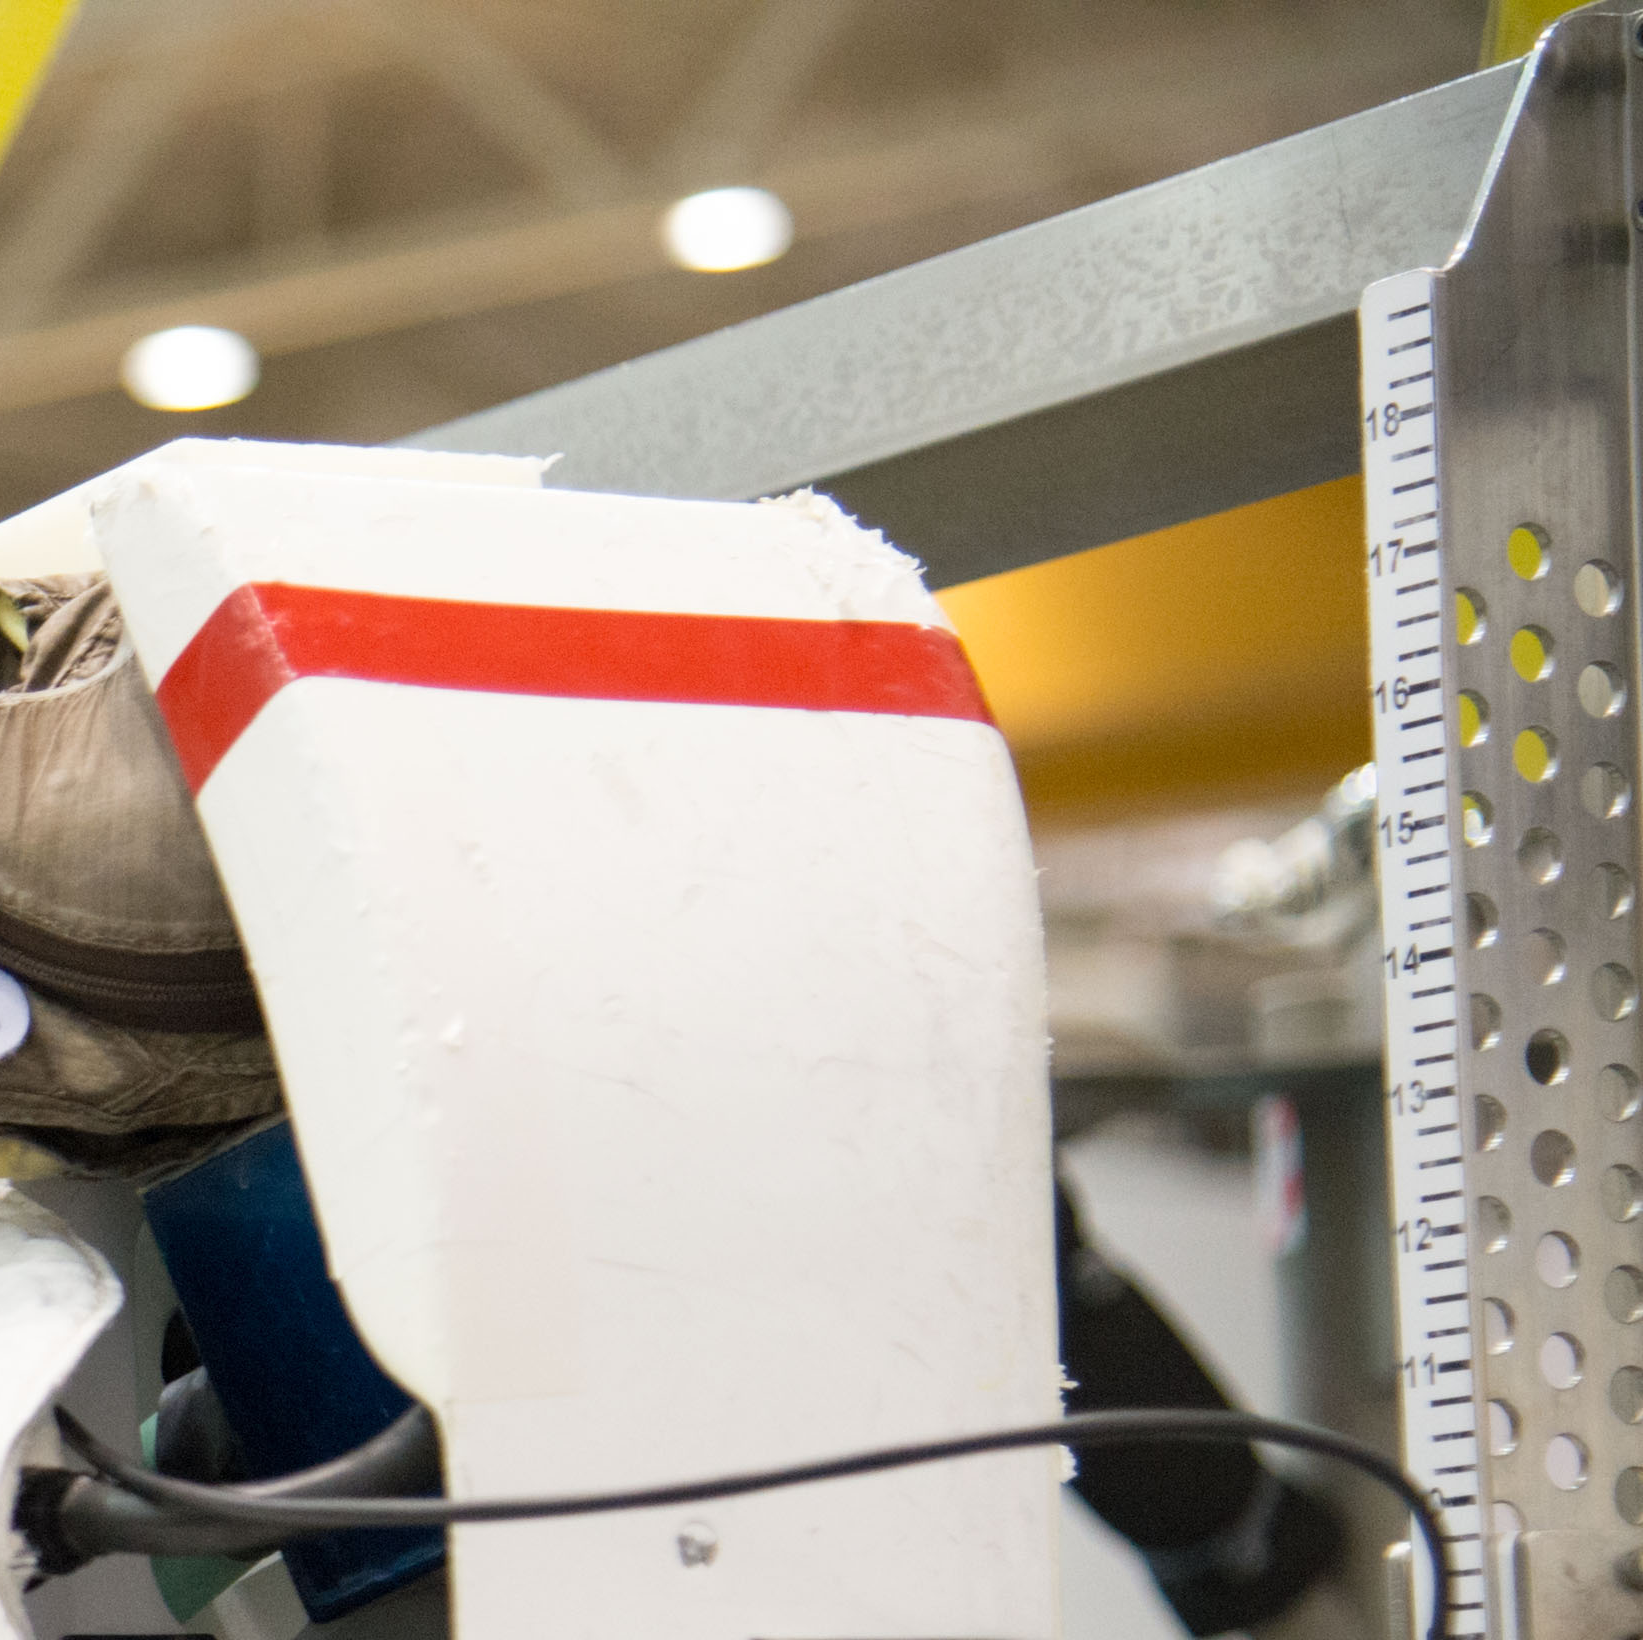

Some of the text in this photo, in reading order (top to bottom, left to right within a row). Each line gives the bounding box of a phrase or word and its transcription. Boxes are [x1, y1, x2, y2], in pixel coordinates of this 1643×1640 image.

[1366, 402, 1401, 441] 18
[1371, 537, 1404, 577] 17
[1375, 676, 1410, 714] 16
[1380, 809, 1415, 848] 15
[1384, 941, 1421, 980] 14
[1390, 1079, 1427, 1116] 13
[1396, 1216, 1433, 1253] 12
[1403, 1352, 1438, 1388] 11
